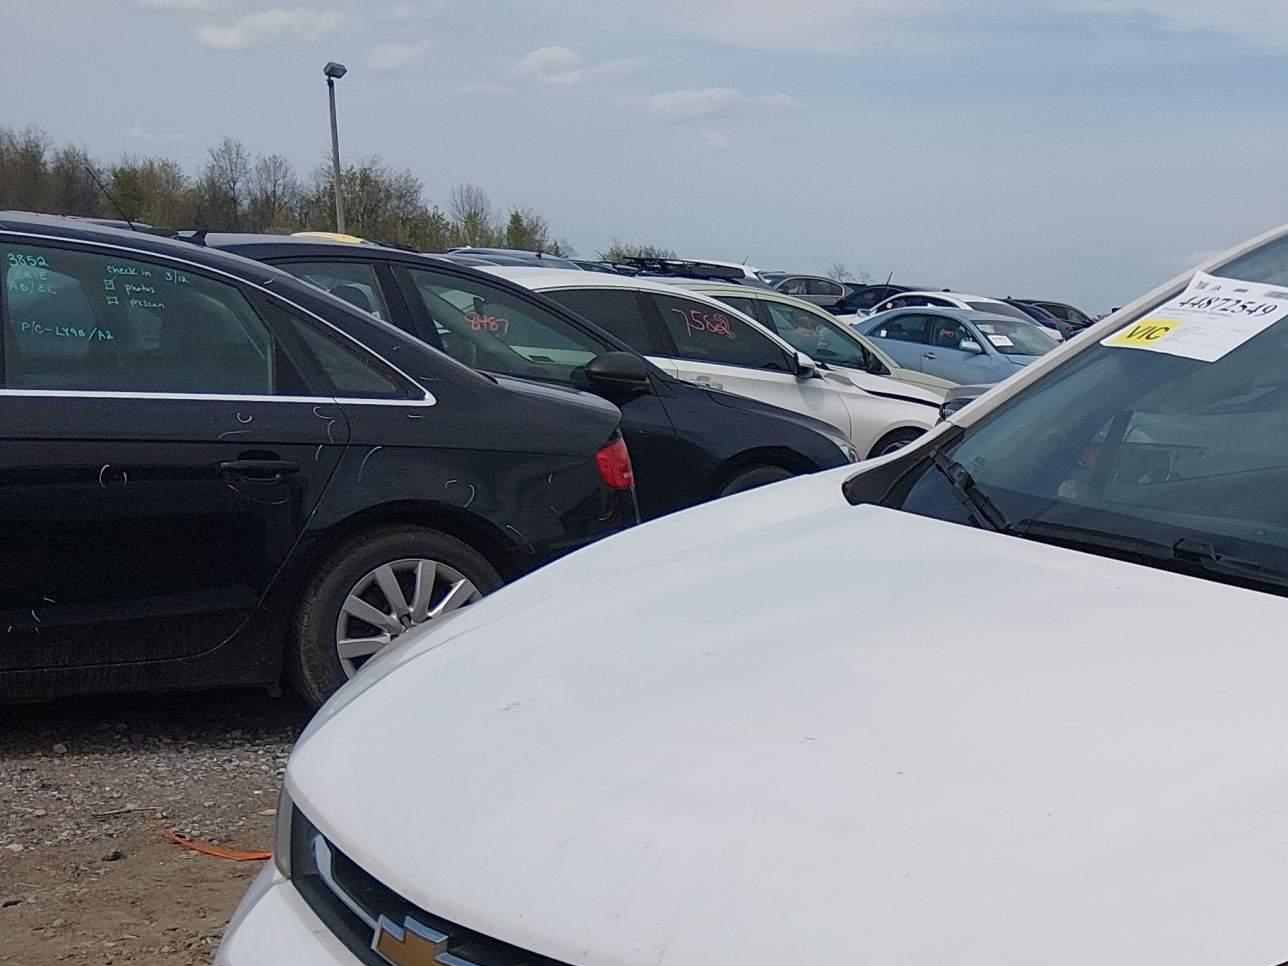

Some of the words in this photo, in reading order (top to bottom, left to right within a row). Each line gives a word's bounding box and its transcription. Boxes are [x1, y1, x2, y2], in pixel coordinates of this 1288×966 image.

[8, 253, 49, 267] 3852
[1179, 295, 1278, 317] 44872549
[1125, 325, 1170, 341] VIC
